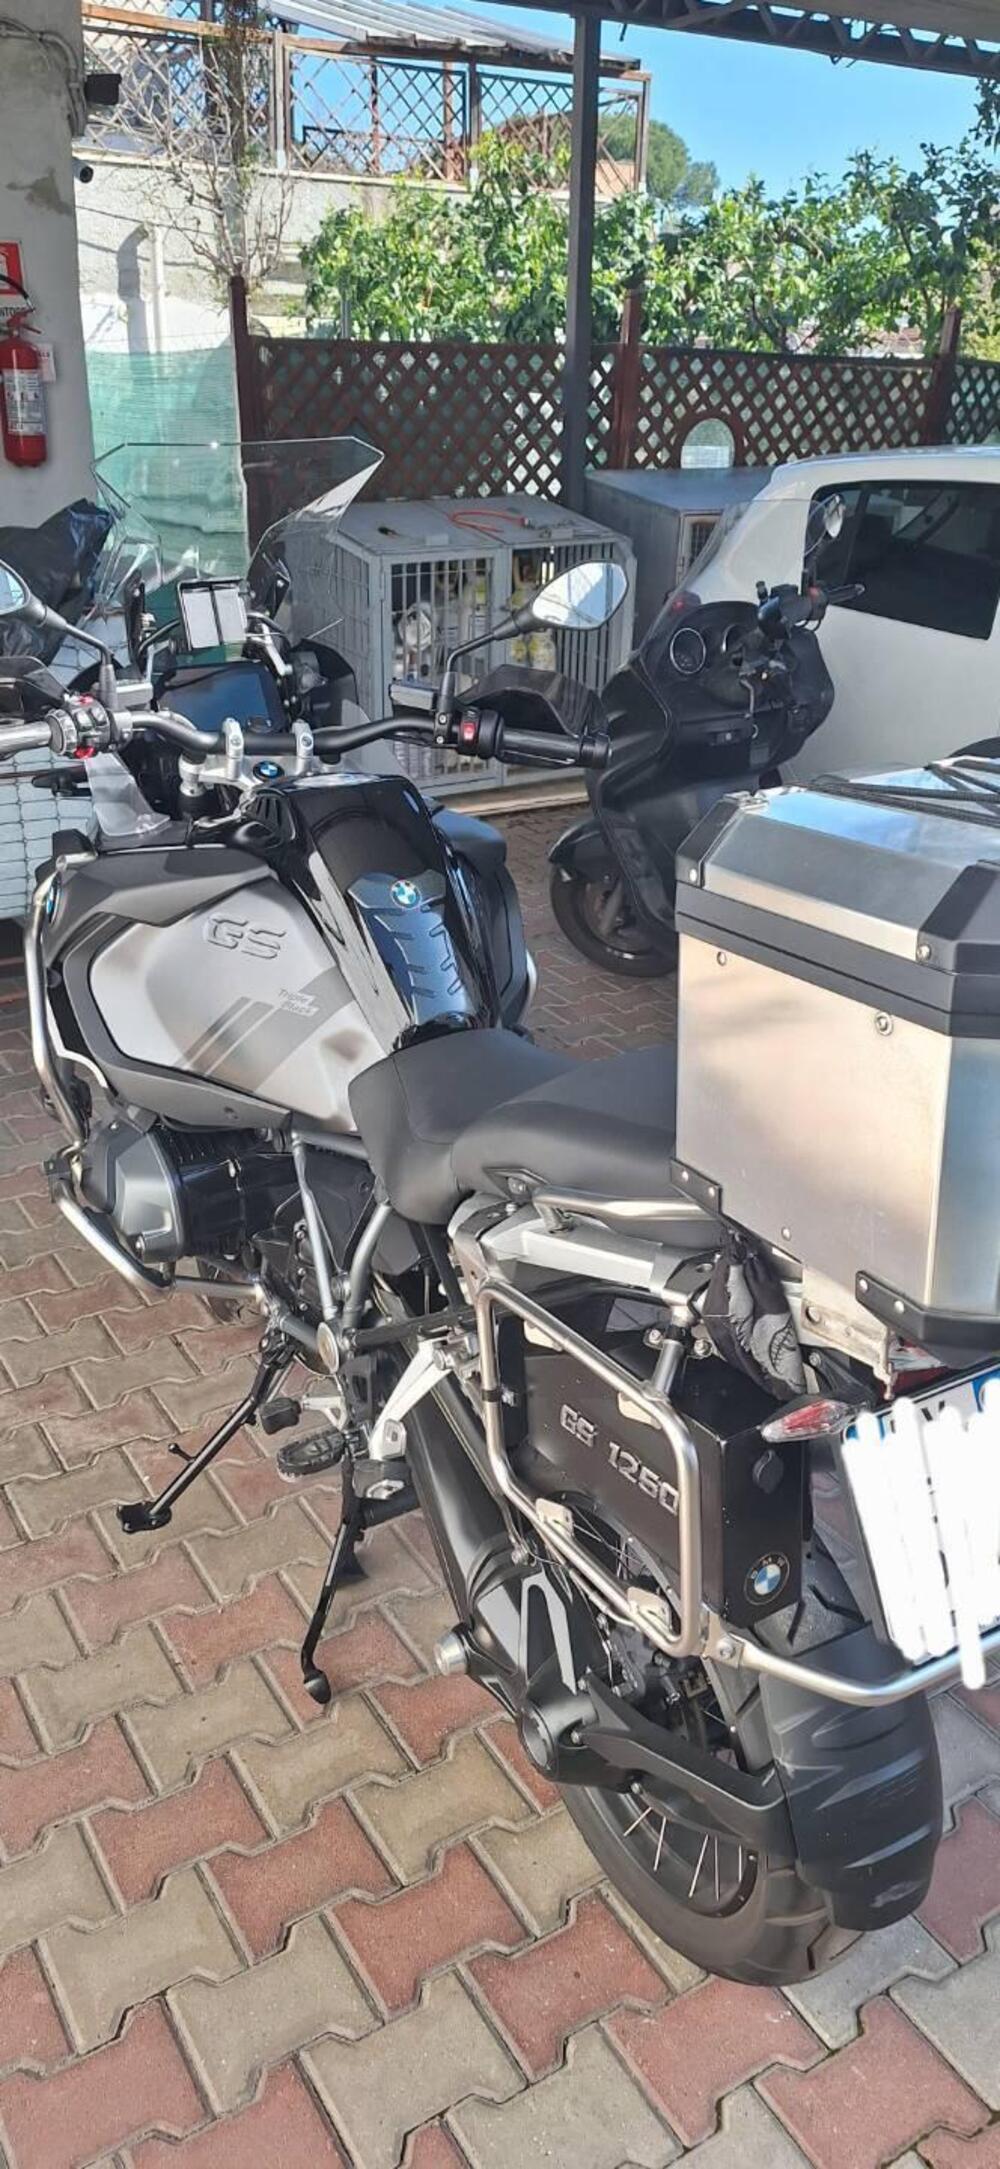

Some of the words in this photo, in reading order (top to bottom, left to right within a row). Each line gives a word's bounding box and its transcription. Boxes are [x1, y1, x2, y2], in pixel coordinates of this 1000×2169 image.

[204, 915, 287, 960] GS
[560, 1403, 596, 1448] GS
[608, 1441, 680, 1517] 1250
